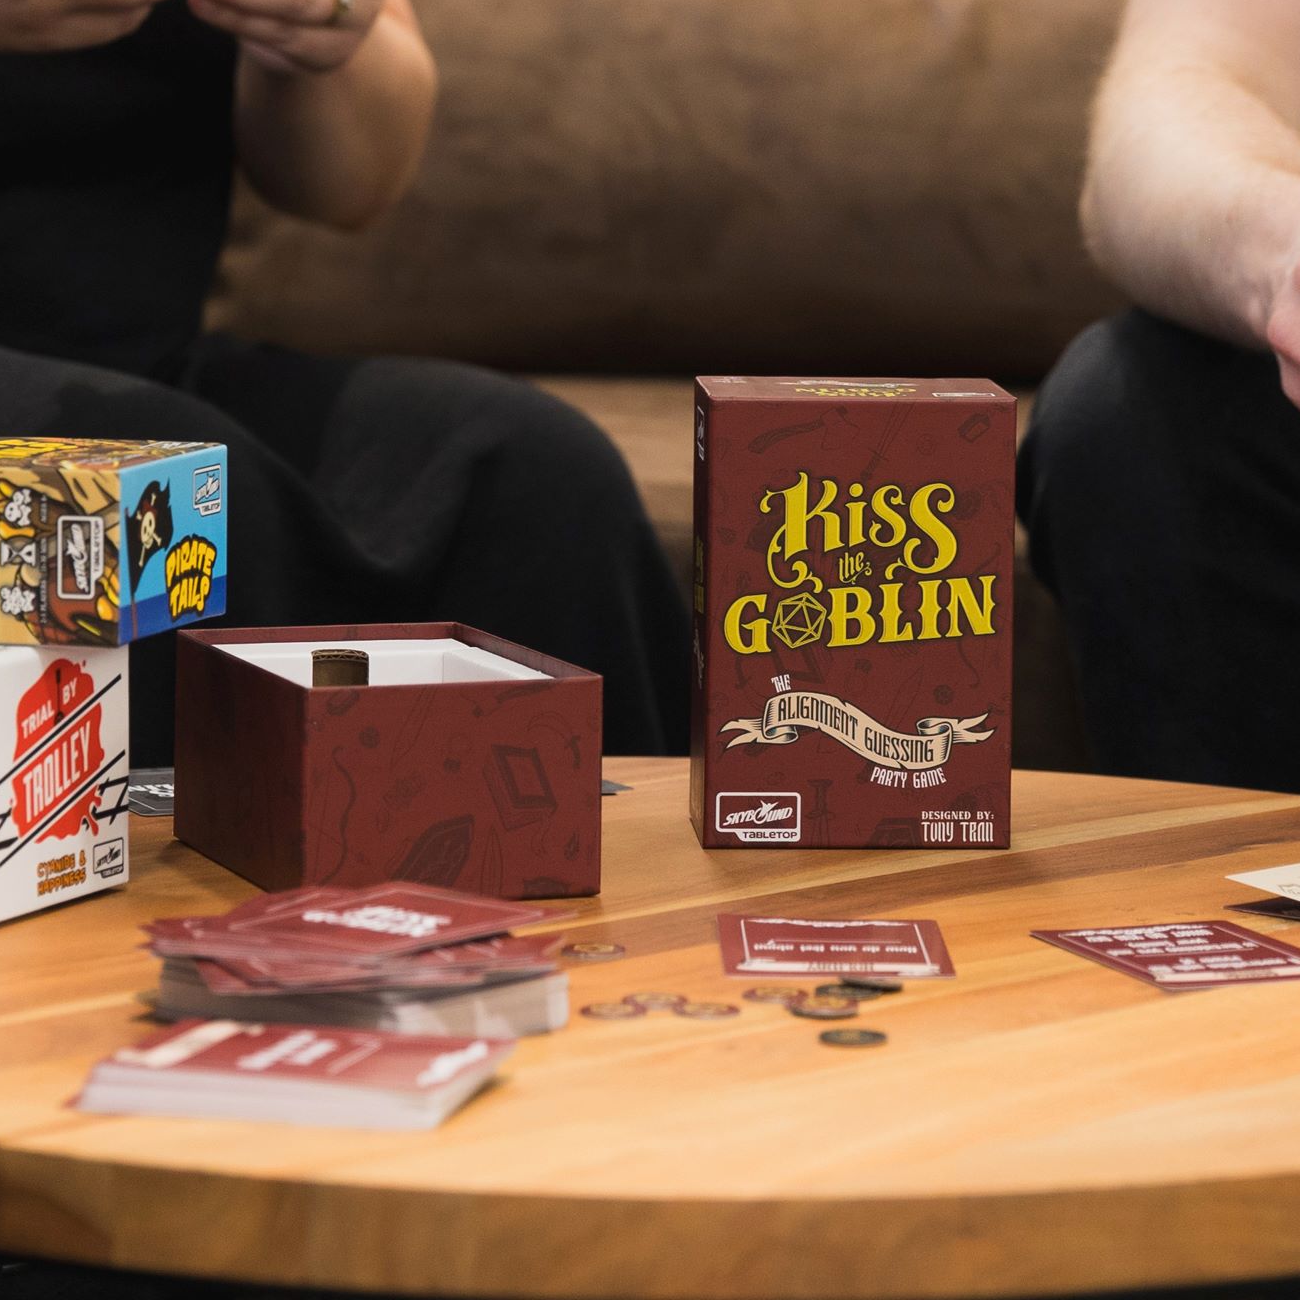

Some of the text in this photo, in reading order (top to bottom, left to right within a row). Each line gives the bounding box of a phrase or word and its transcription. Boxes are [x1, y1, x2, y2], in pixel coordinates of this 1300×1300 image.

[760, 472, 957, 593] Kiss
[166, 540, 216, 587] PIRATE
[839, 552, 872, 584] the
[170, 575, 210, 617] TAILS
[724, 575, 996, 654] GOBLIN
[771, 674, 791, 692] THE
[22, 678, 77, 739] TRIAL BY
[778, 696, 934, 763] ALIGNMENT GUESSING
[23, 721, 91, 823] TROLLEY
[870, 767, 947, 789] PARTY GAME
[722, 801, 793, 826] SKYBOUND
[921, 811, 995, 820] DESIGNED BY:
[921, 821, 994, 842] TONY TRAN
[37, 850, 87, 878] CYANIDE &
[37, 867, 87, 896] HAPPINESS
